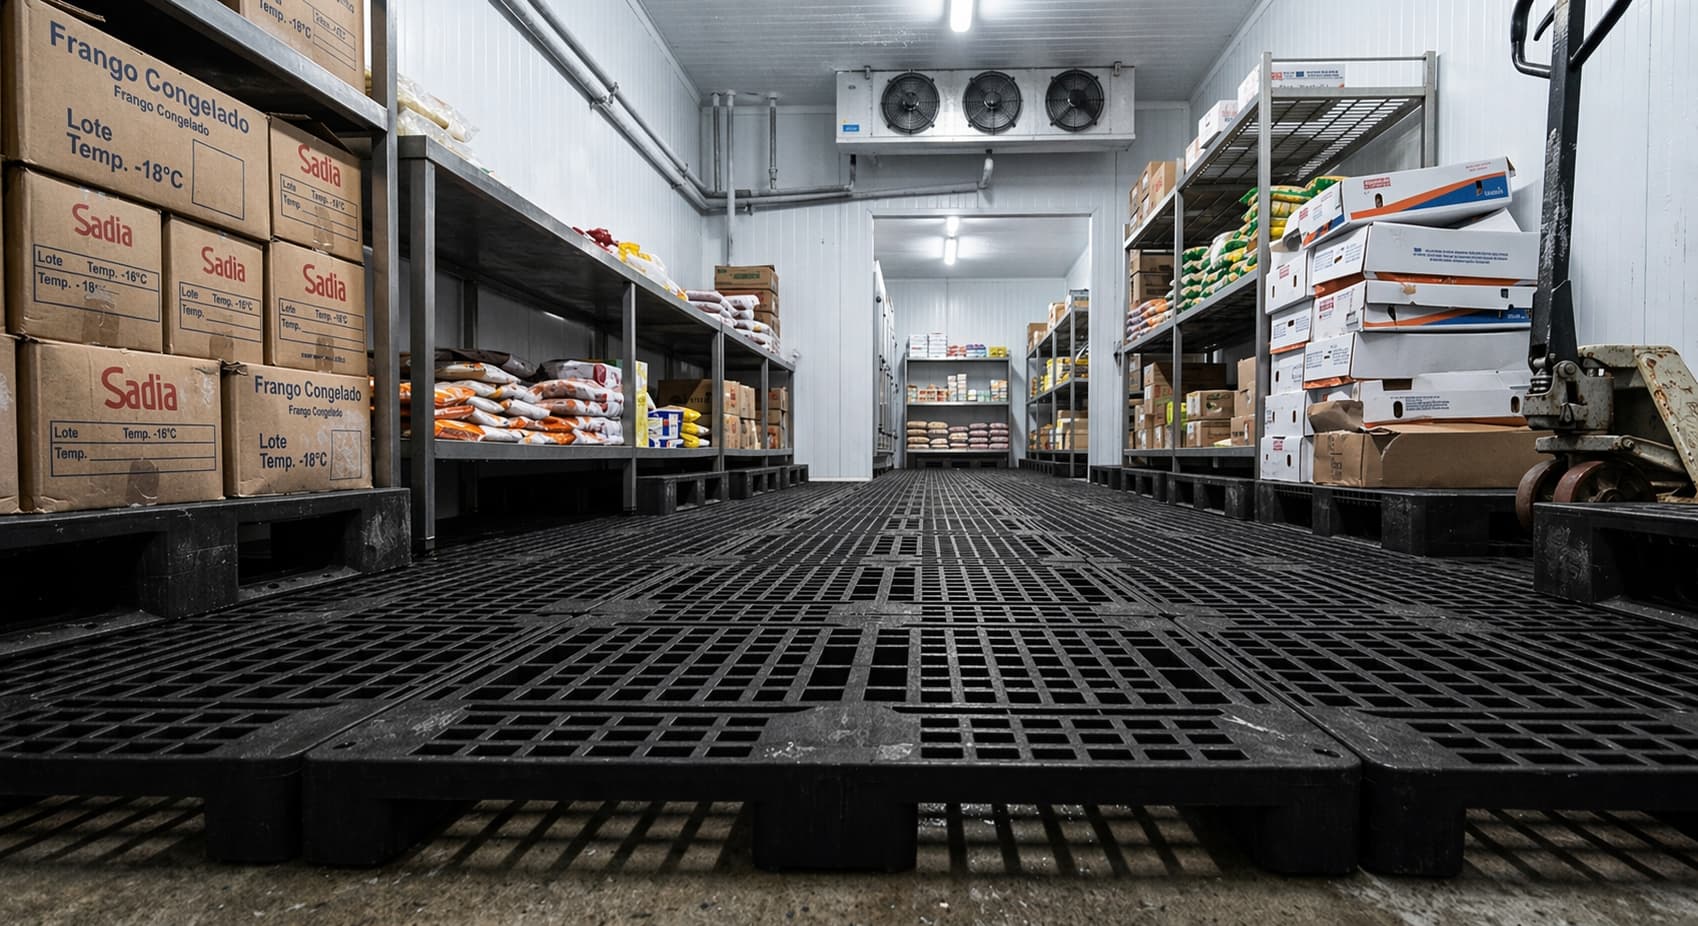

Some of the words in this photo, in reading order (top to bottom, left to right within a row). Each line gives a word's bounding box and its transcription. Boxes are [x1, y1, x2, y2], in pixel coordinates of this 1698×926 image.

[50, 20, 138, 82] Frango
[145, 68, 250, 134] Congelado
[66, 107, 113, 141] Lote
[114, 84, 154, 112] Frango
[156, 103, 210, 137] Congelado
[66, 131, 128, 173] Temp.
[297, 143, 342, 188] Sadia
[71, 203, 133, 248] Sadia
[37, 250, 63, 267] Lote
[86, 261, 118, 280] Temp.
[201, 246, 246, 283] Sadia
[37, 271, 71, 291] Temp.
[302, 263, 347, 303] Sadia
[182, 303, 205, 319] Temp.
[101, 366, 178, 412] Sadia
[254, 375, 302, 401] Frango
[304, 380, 362, 404] Congelado
[288, 404, 312, 418] Frango
[312, 406, 343, 419] Congelado
[54, 426, 79, 439] Lote
[122, 427, 151, 442] Temp.
[259, 432, 288, 449] Lote
[54, 446, 88, 462] Temp.
[259, 452, 296, 473] Temp.
